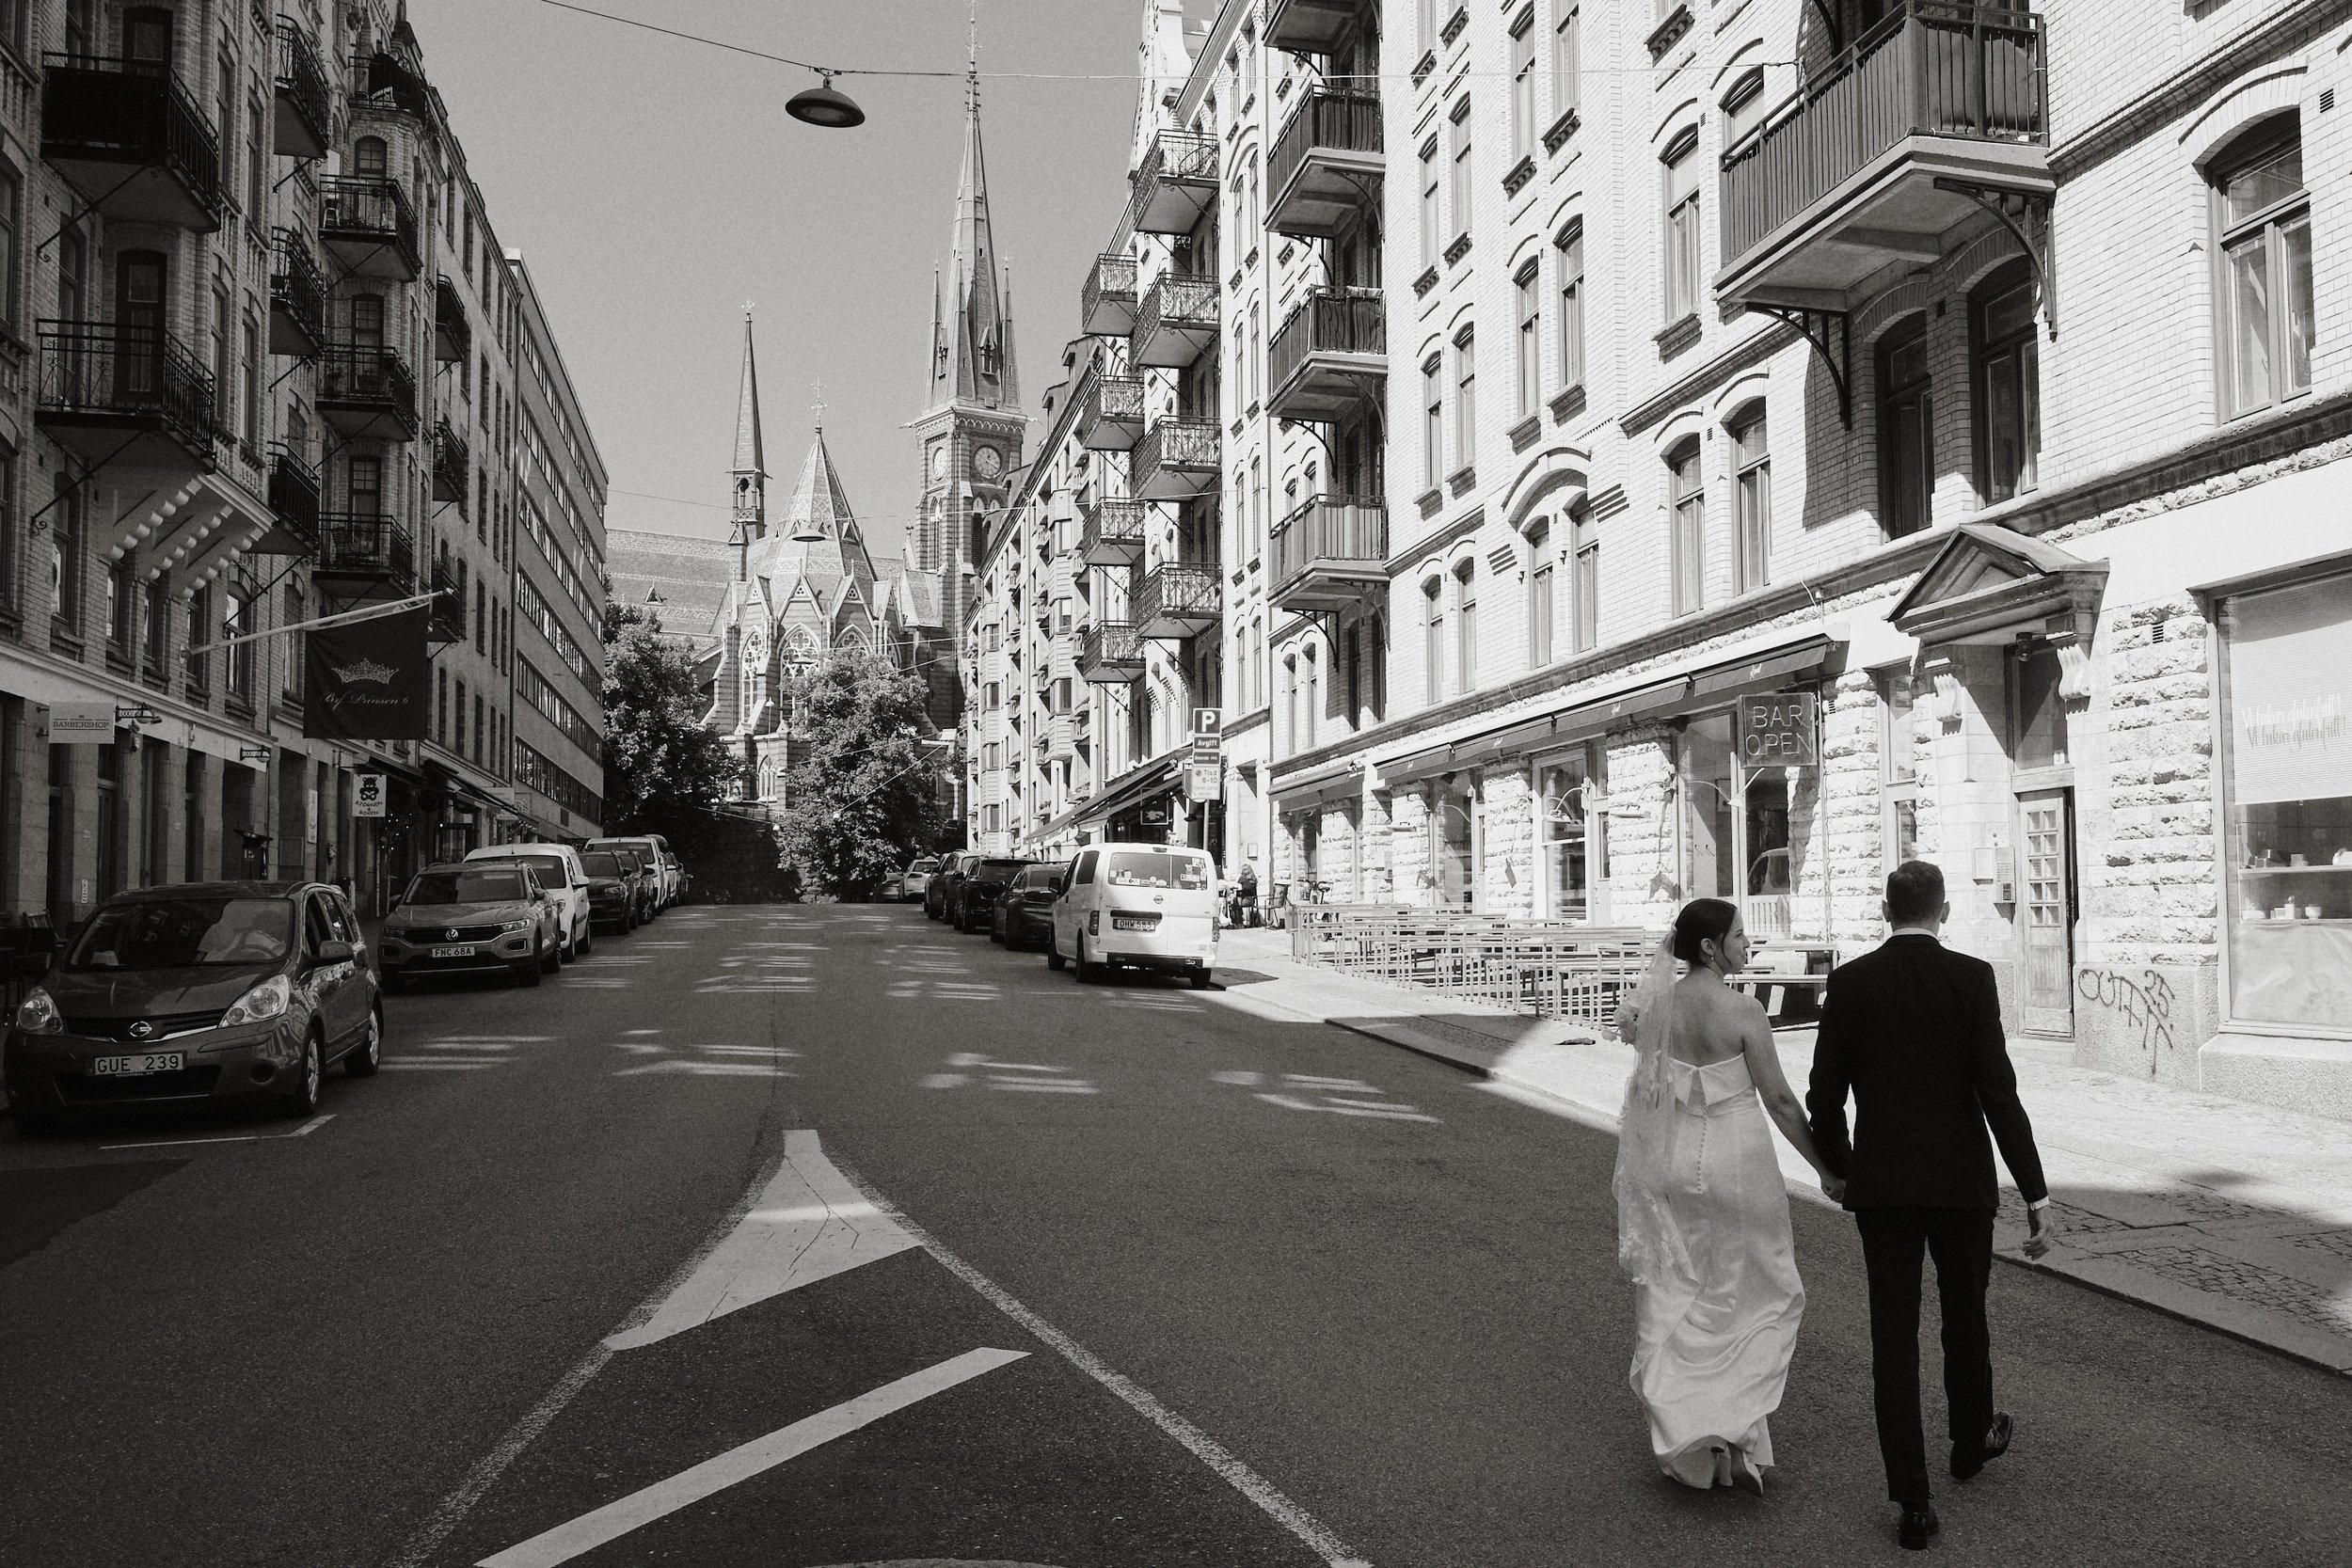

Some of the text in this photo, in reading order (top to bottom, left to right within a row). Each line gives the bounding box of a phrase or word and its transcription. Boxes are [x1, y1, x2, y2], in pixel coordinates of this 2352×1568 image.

[53, 721, 109, 729] BARBERSHOP
[1201, 710, 1216, 733] P
[1753, 705, 1803, 728] BAR
[1197, 738, 1217, 749] Avgift
[1745, 733, 1812, 756] OPEN
[453, 947, 471, 956] 68A
[98, 1054, 179, 1073] GUE 239
